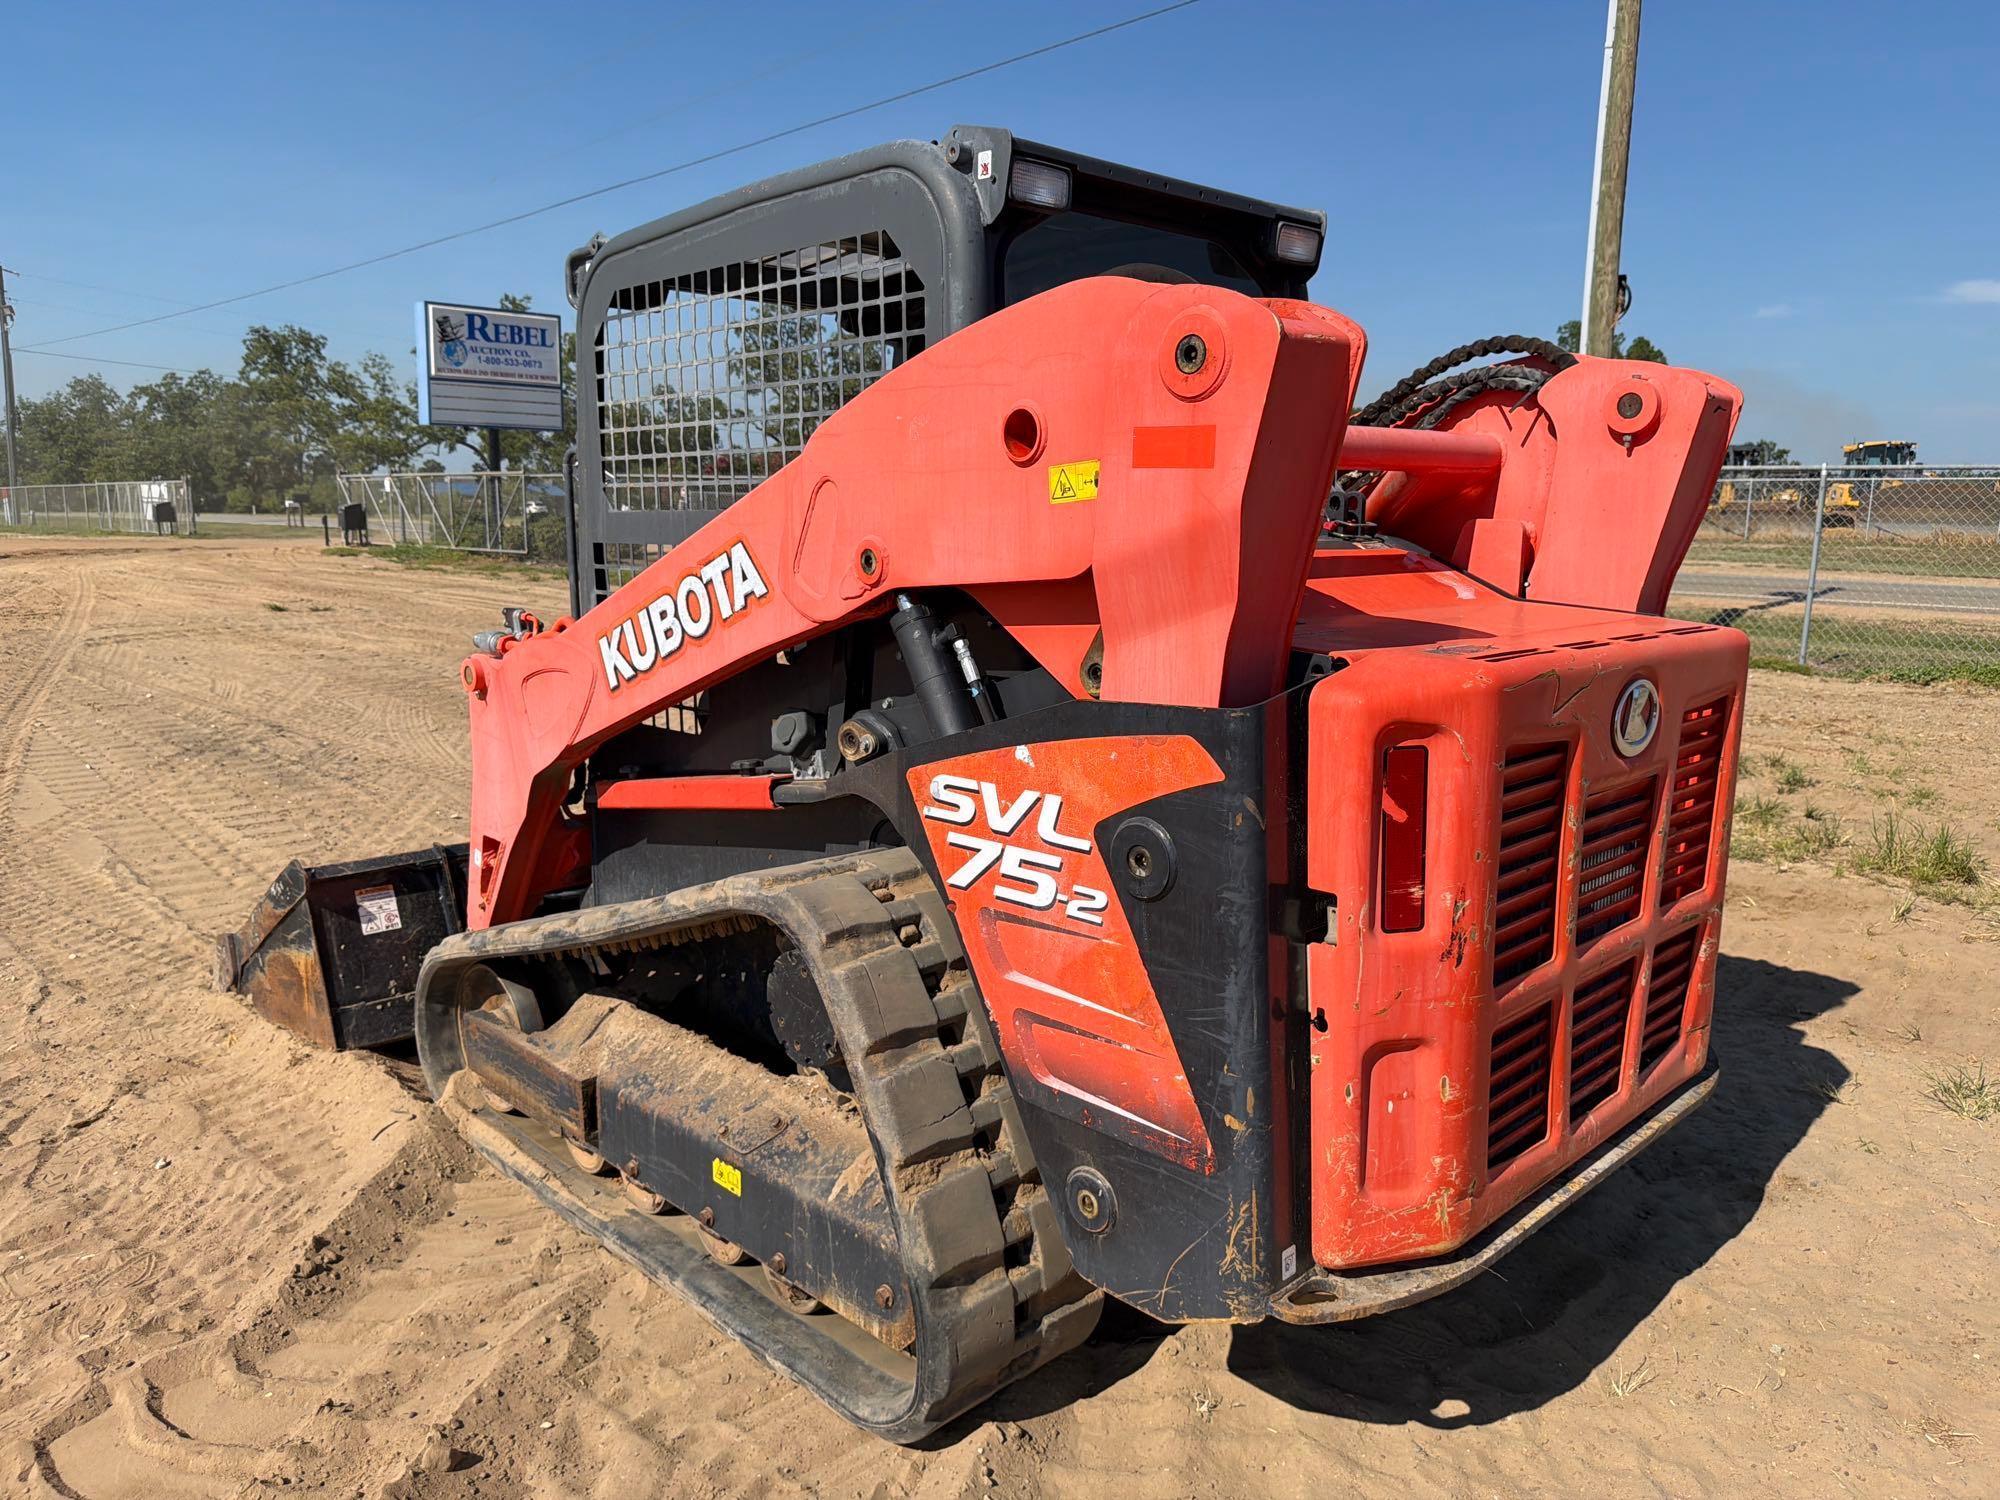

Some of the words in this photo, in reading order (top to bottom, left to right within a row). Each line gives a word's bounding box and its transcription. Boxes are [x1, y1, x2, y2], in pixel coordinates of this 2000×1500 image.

[466, 314, 554, 348] REBEL
[469, 345, 512, 357] AUCTION
[598, 540, 769, 690] KUBOTA
[922, 774, 1092, 854] SVL
[945, 831, 1109, 926] 75-2
